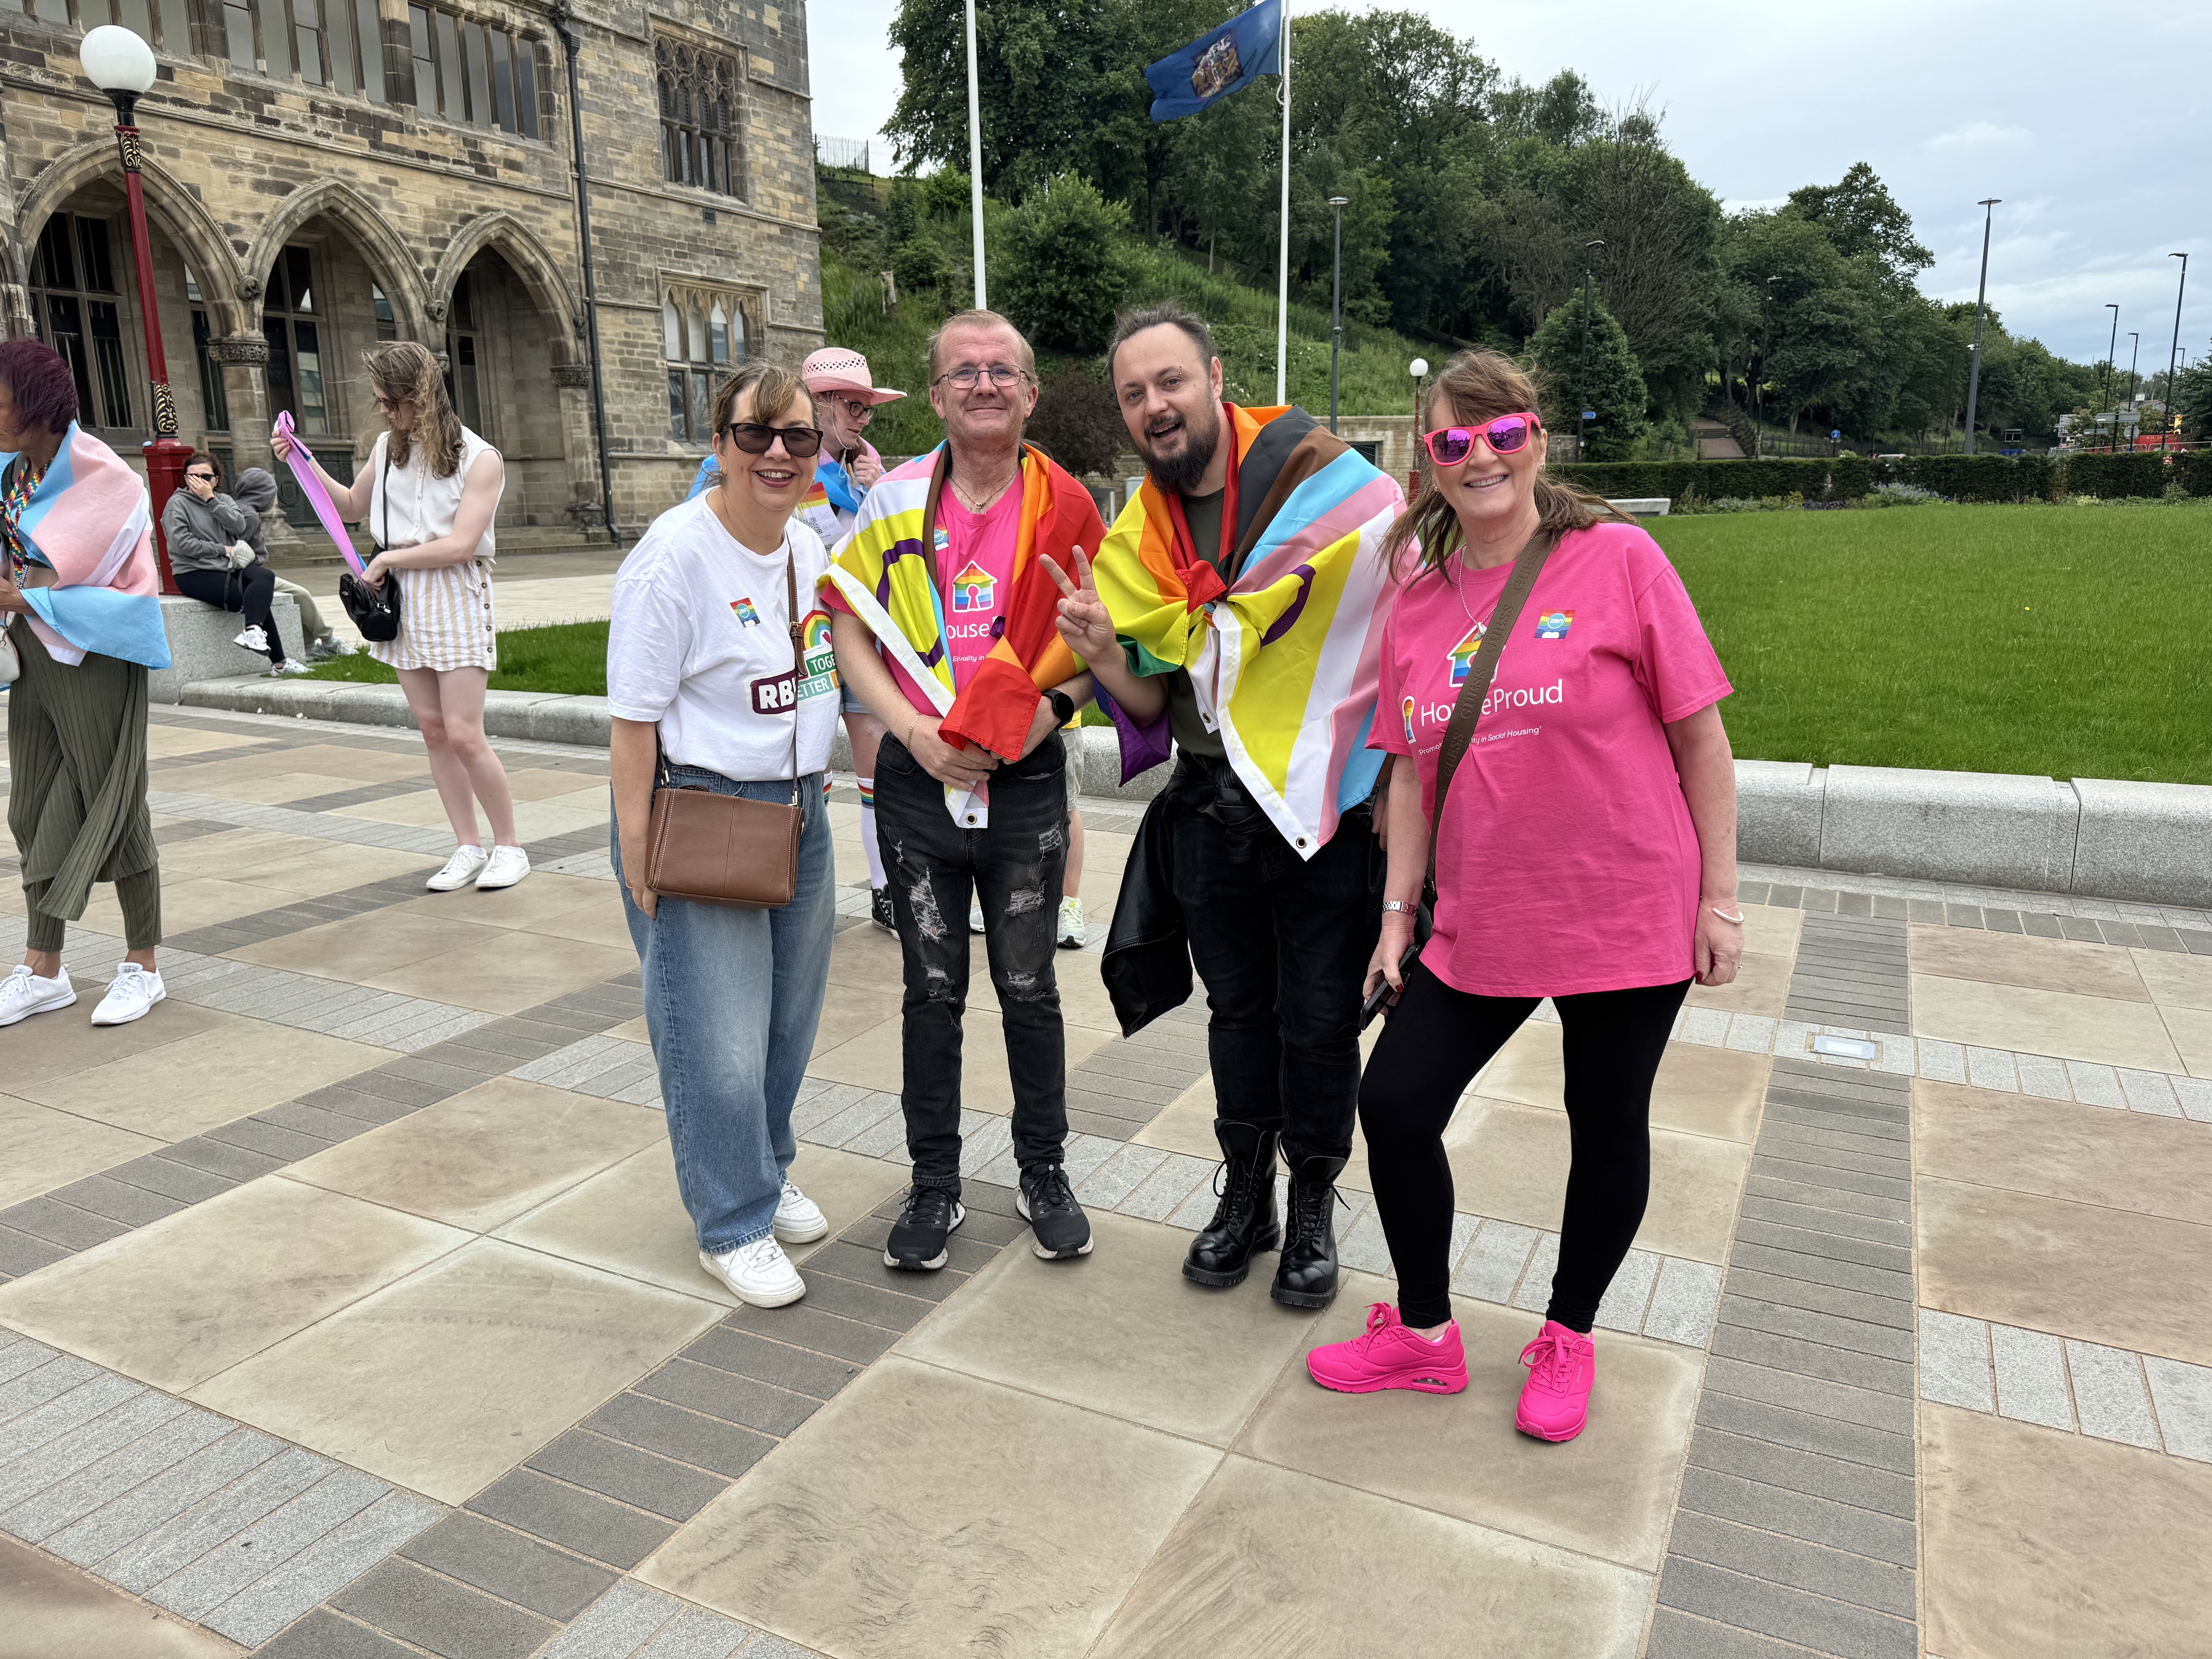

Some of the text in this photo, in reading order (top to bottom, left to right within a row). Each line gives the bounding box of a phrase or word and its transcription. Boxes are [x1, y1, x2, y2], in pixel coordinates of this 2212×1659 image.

[810, 654, 835, 672] TOGE
[798, 678, 829, 698] ETTER
[1421, 679, 1563, 726] HoeProud
[1418, 741, 1443, 756] 'Promot
[1471, 737, 1480, 745] lity
[1488, 731, 1506, 741] Social
[1507, 726, 1541, 737] Housing'
